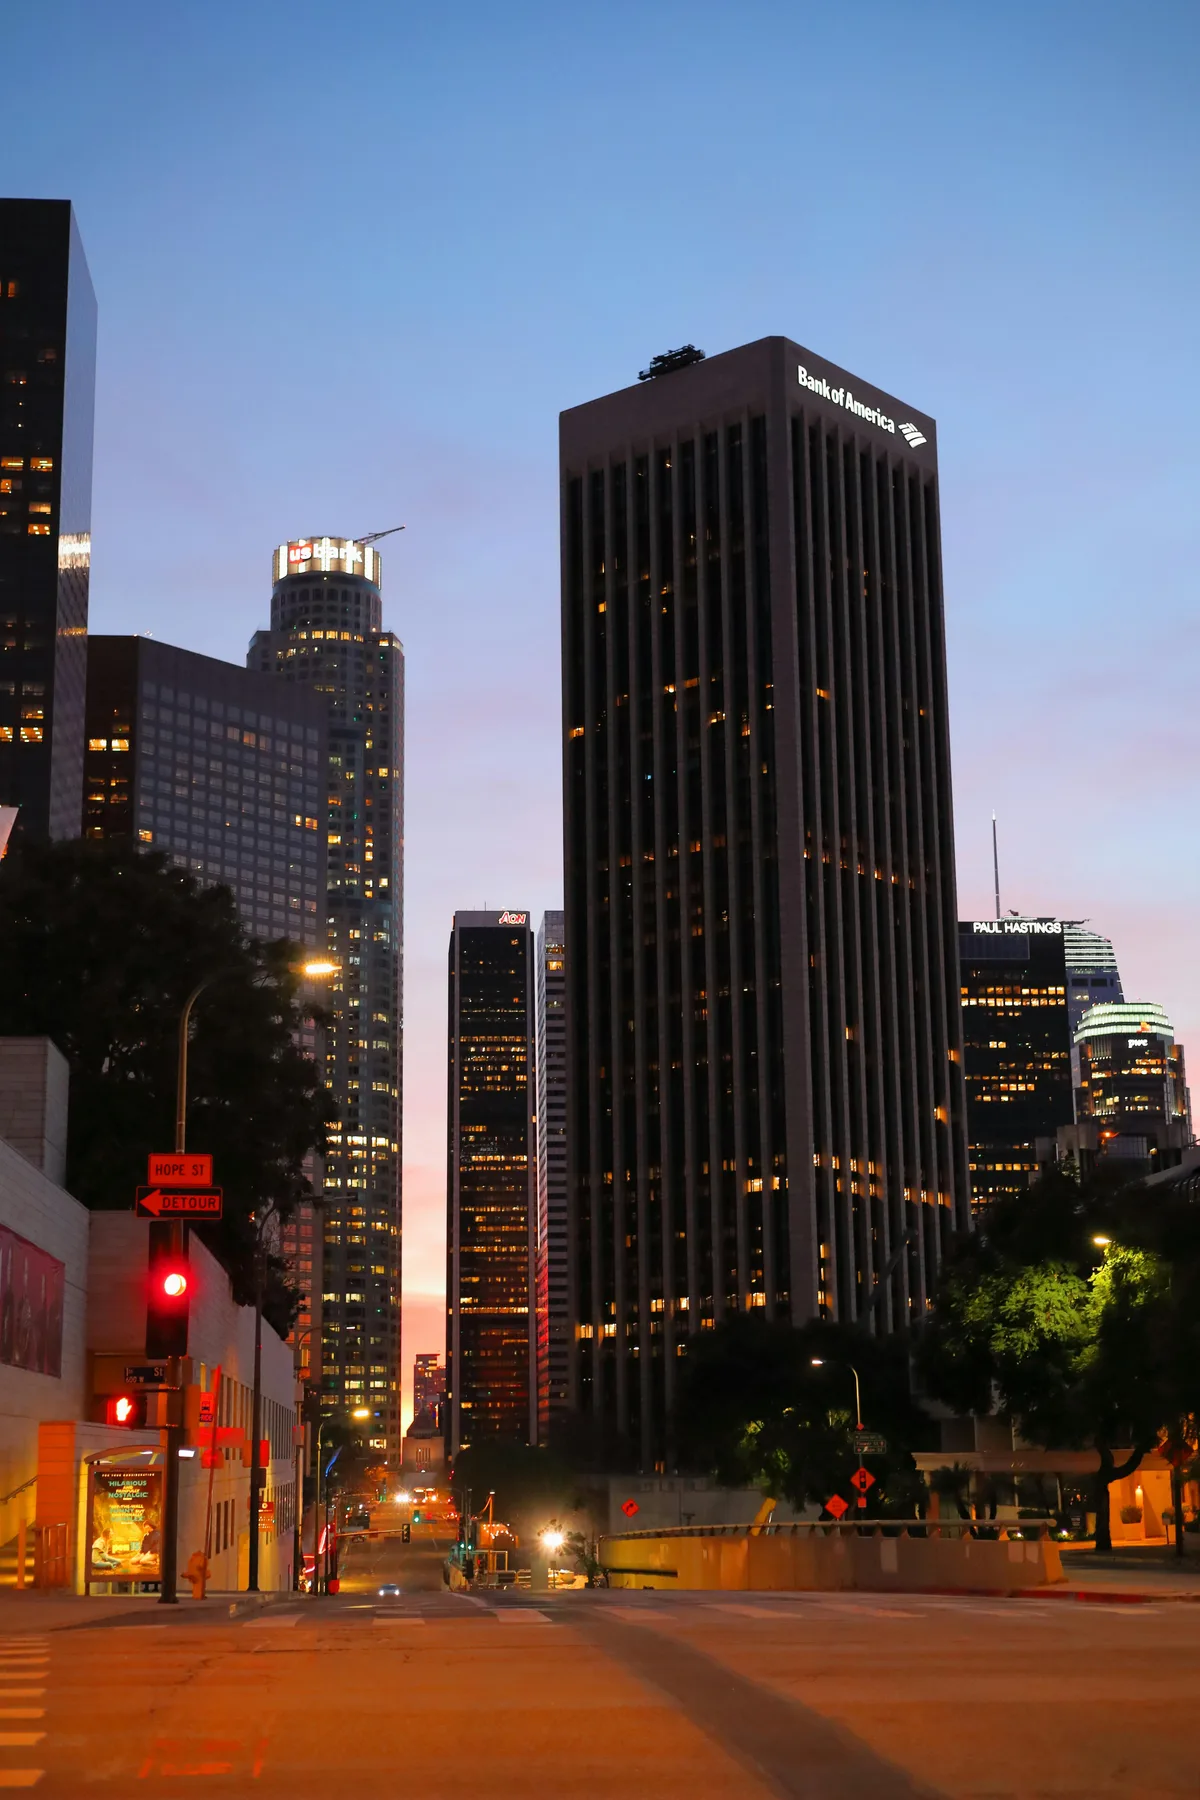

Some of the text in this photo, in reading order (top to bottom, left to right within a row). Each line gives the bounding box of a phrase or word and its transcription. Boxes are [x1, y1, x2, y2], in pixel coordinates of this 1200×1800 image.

[798, 365, 895, 434] Bank of America
[973, 922, 1062, 934] PAUL HASTINGS
[1128, 1038, 1148, 1049] pwc
[155, 1164, 205, 1176] HOPE ST
[162, 1197, 216, 1209] DETOUR
[153, 1366, 163, 1377] St
